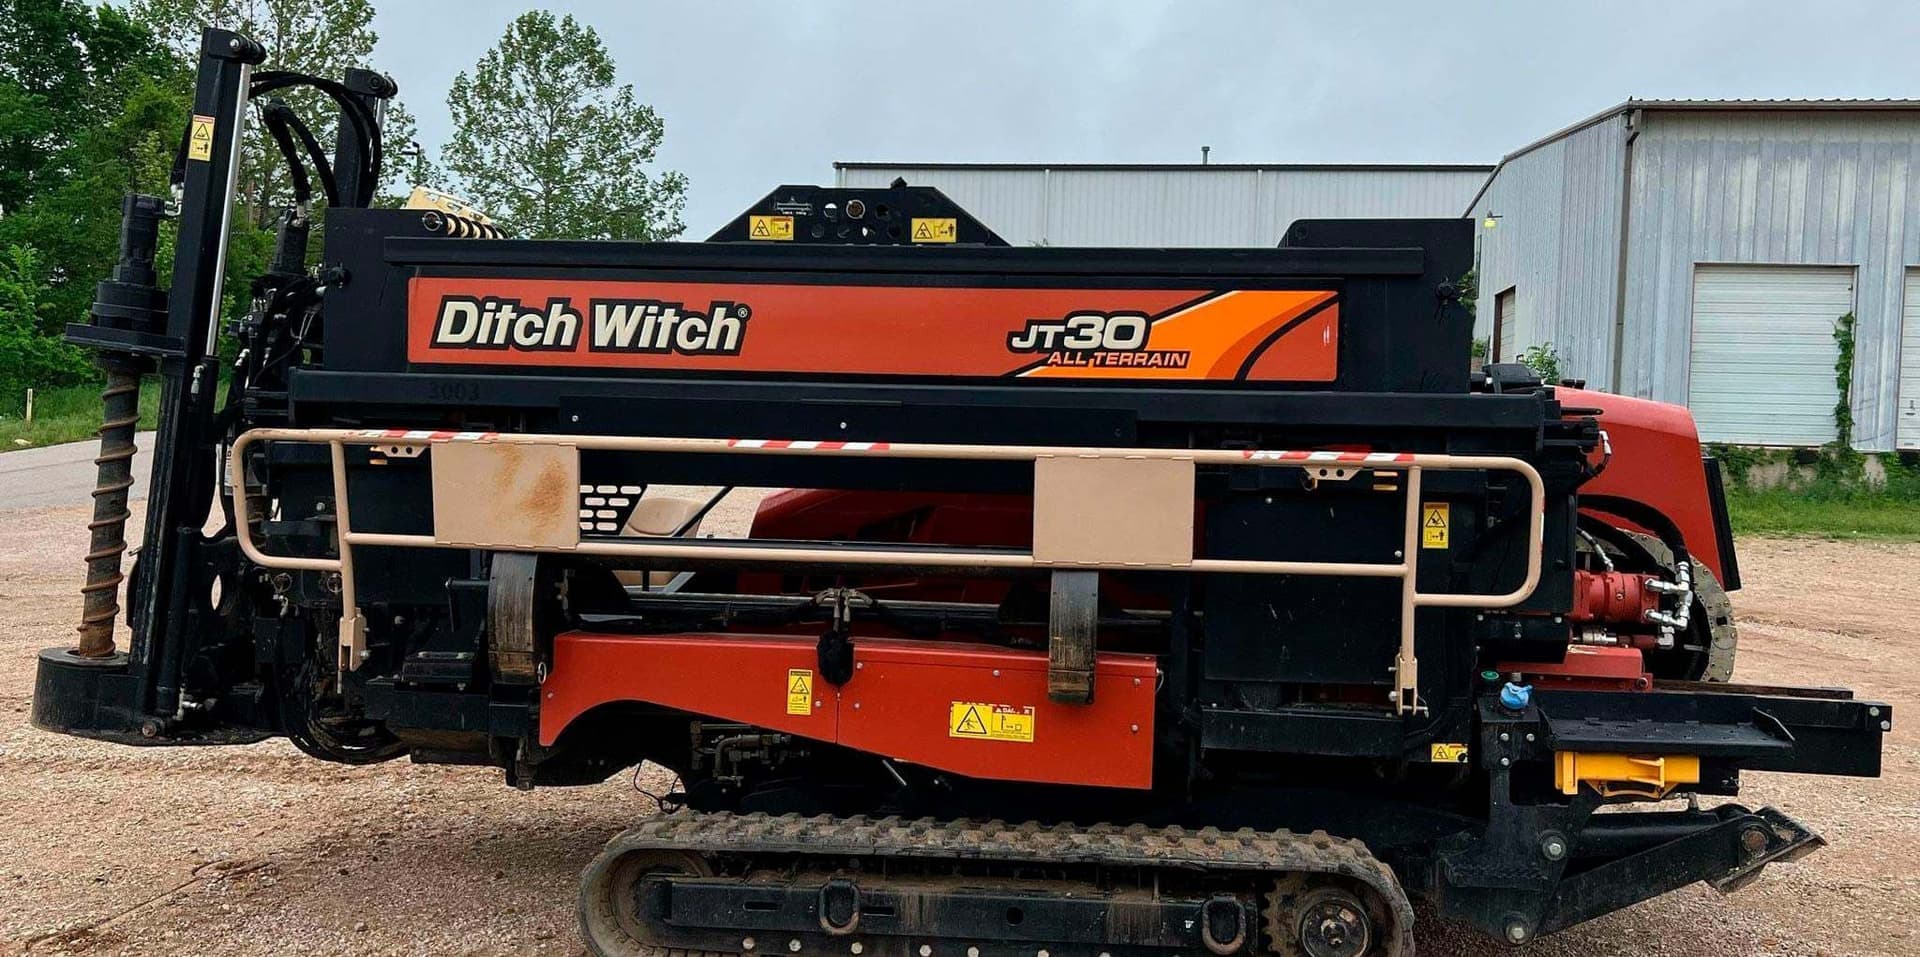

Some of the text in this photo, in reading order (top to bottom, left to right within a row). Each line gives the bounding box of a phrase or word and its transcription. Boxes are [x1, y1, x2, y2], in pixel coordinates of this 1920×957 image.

[436, 300, 581, 346] Ditch
[1011, 315, 1147, 350] JT30
[1047, 351, 1188, 368] ALL TERRAIN
